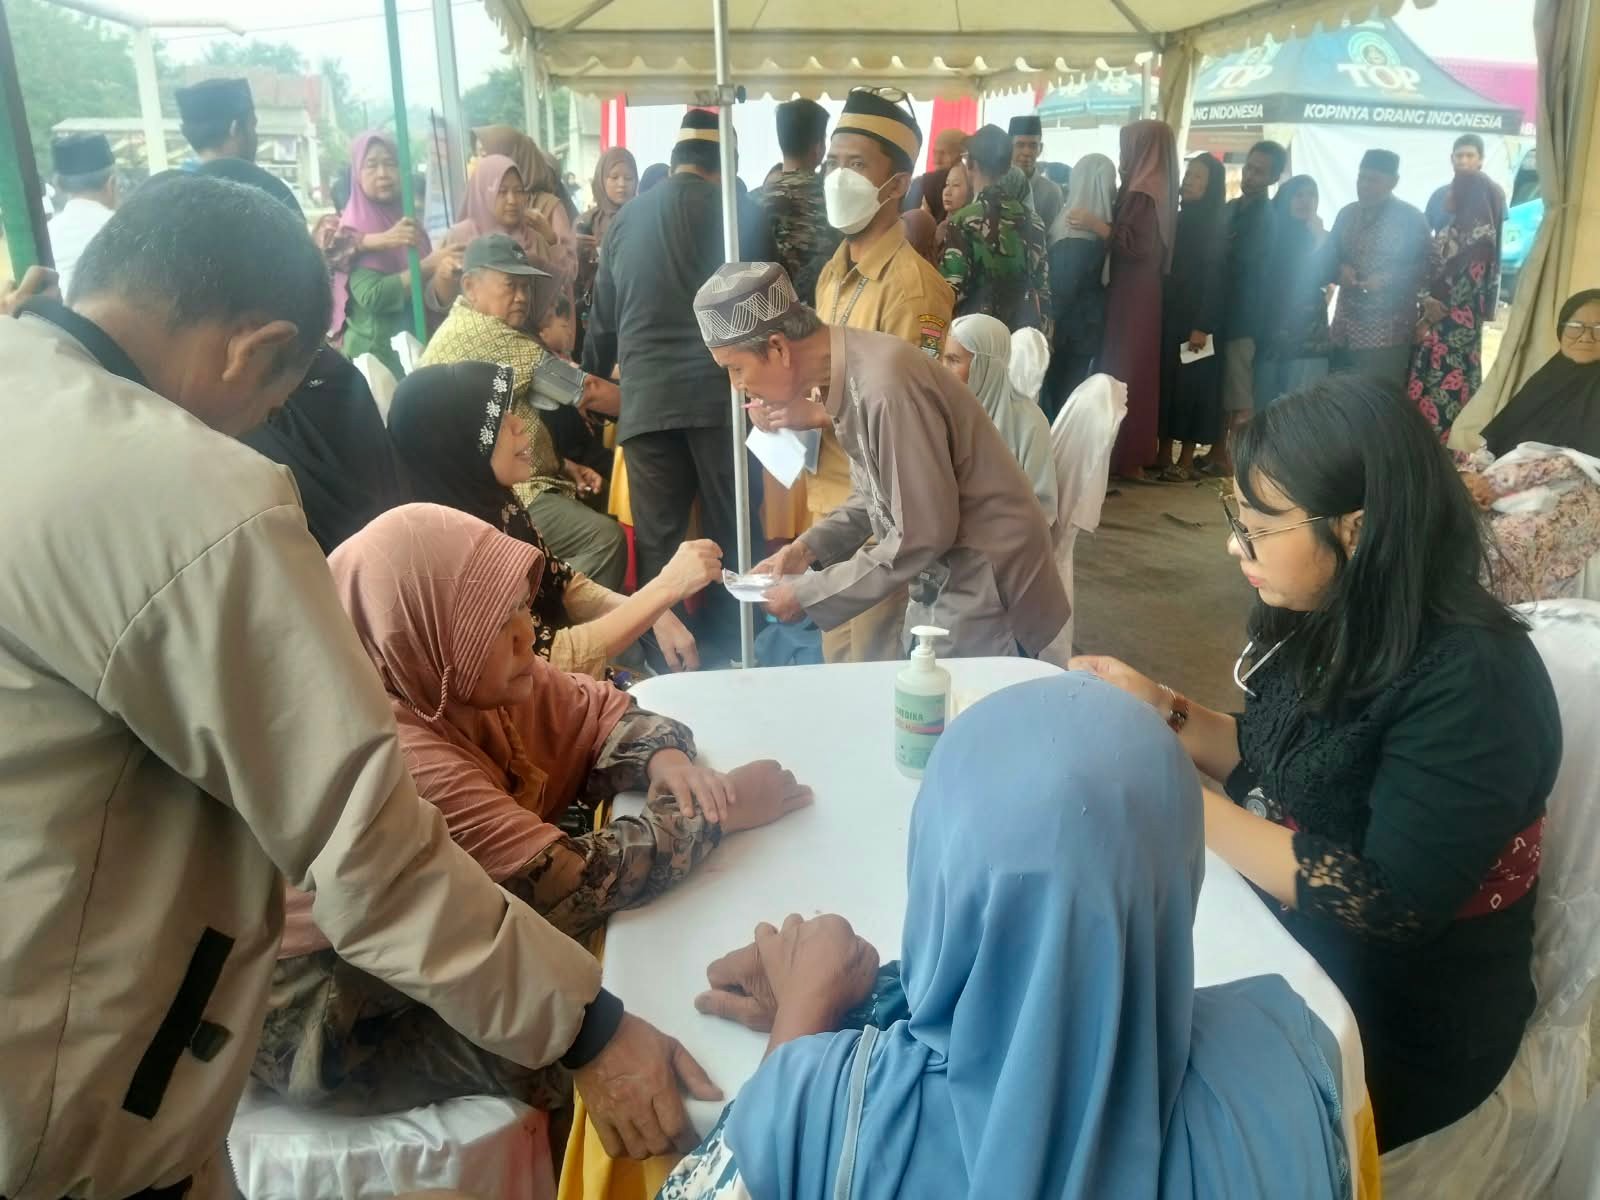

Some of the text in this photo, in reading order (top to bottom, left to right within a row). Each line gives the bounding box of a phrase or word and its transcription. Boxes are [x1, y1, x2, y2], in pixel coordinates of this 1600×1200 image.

[1205, 65, 1273, 89] TOP
[1337, 63, 1420, 91] TOP
[1209, 103, 1264, 121] INDONESIA
[1303, 103, 1369, 121] KOPINYA
[1373, 106, 1426, 124] ORANG
[1426, 110, 1503, 129] INDONESIA
